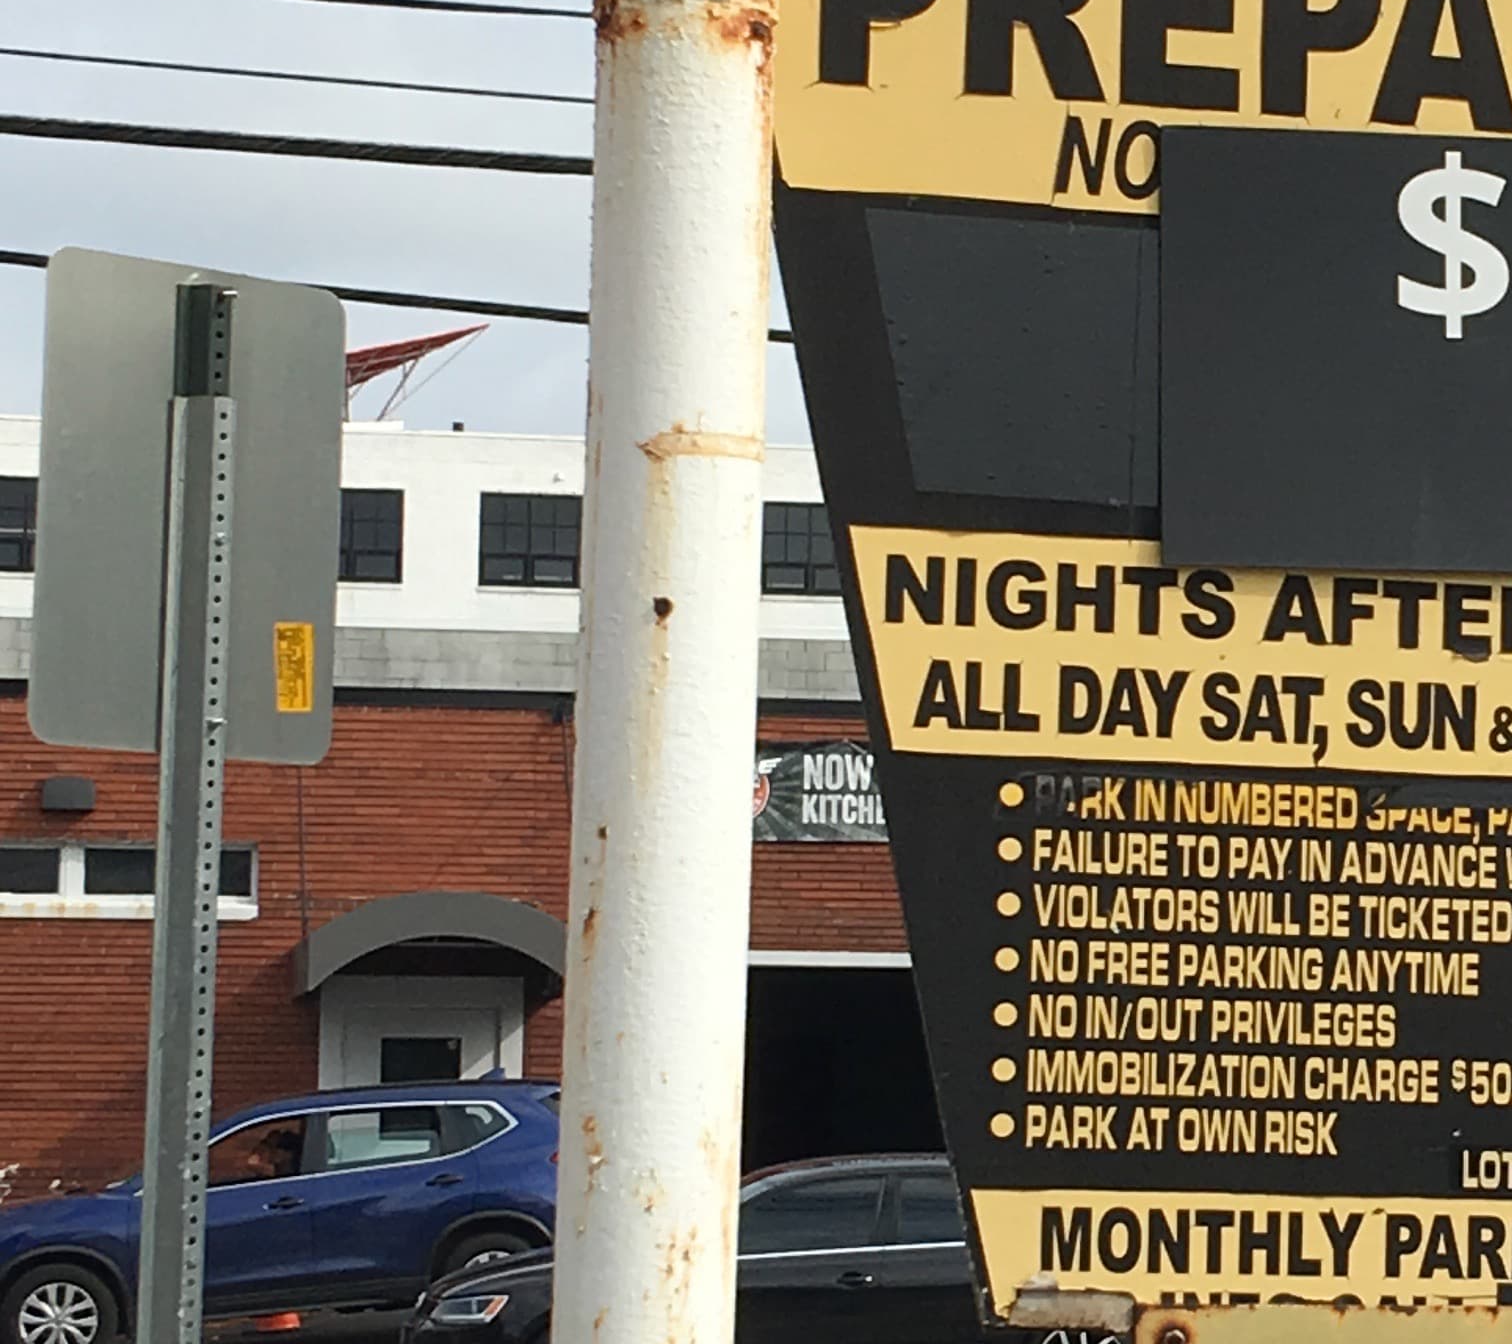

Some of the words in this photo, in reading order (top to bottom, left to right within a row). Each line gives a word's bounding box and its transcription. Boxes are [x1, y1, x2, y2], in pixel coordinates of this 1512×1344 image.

[884, 553, 1236, 640] NIGHTS
[913, 659, 1040, 732] ALL
[1057, 665, 1194, 738] DAY
[1200, 672, 1329, 765] SAT,
[1346, 678, 1476, 752] SUN
[803, 753, 875, 791] NOW
[1135, 778, 1166, 822] IN
[1174, 780, 1359, 830] NUMBERED
[1033, 828, 1169, 876] FAILURE
[1177, 834, 1220, 879] TO
[1229, 836, 1292, 881] PAY
[1301, 839, 1332, 883] IN
[1340, 841, 1498, 889] ADVANCE
[1034, 884, 1220, 933] VIOLATORS
[1228, 892, 1300, 935] WILL
[1309, 894, 1351, 938] BE
[1359, 895, 1512, 943] TICKETED
[1030, 939, 1079, 984] NO
[1087, 942, 1170, 987] FREE
[1178, 944, 1324, 991] PARKING
[1331, 948, 1480, 996] ANYTIME
[1028, 994, 1078, 1039] NO
[1086, 996, 1204, 1042] IN/OUT
[1211, 1000, 1397, 1048] PRIVILEGES
[1027, 1049, 1296, 1099] IMMOBILIZATION
[1304, 1057, 1440, 1103] CHARGE
[1025, 1104, 1118, 1150] PARK
[1126, 1106, 1170, 1150] AT
[1178, 1108, 1257, 1153] OWN
[1264, 1111, 1339, 1155] RISK
[1040, 1206, 1363, 1276] MONTHLY
